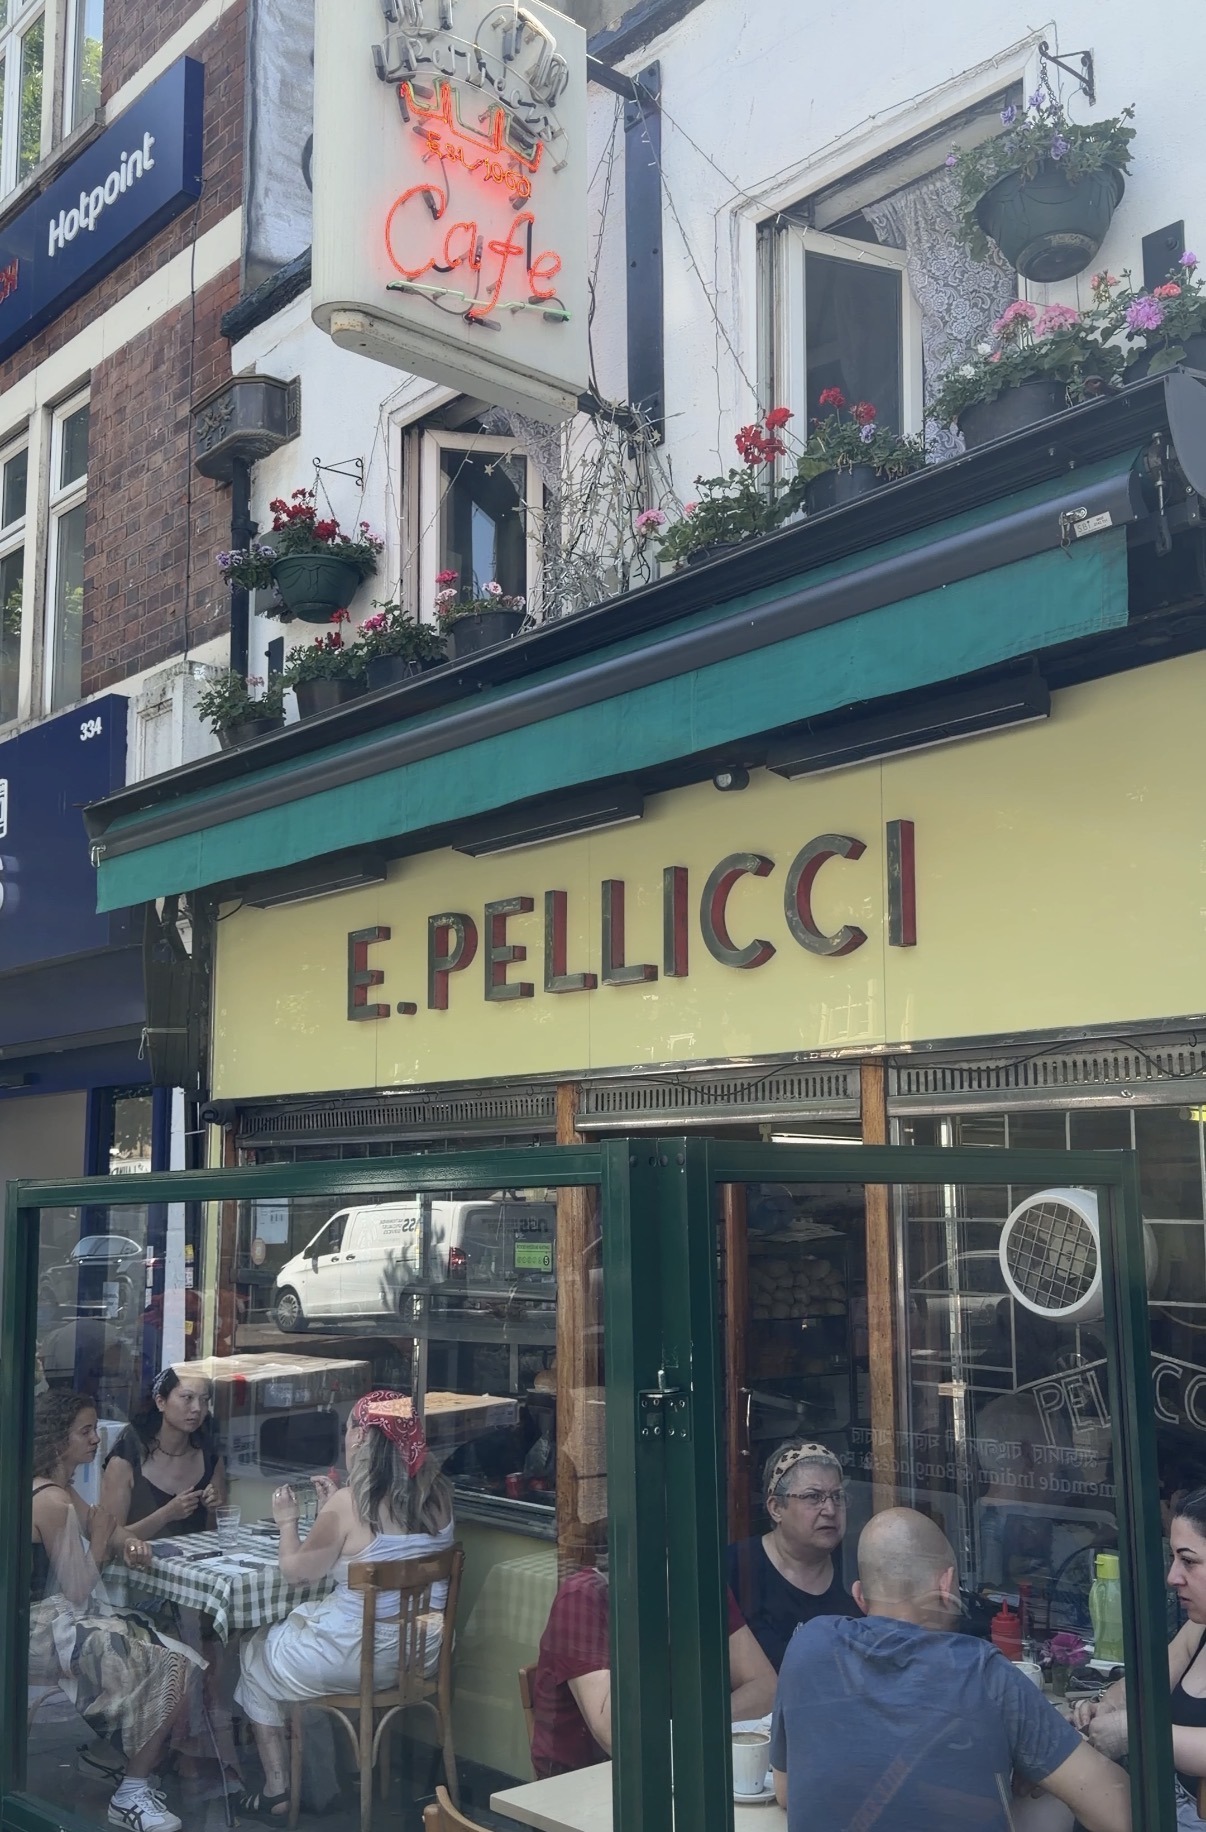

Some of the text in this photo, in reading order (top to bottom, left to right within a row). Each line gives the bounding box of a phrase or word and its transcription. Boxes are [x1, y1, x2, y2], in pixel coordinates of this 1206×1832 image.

[47, 131, 157, 258] Hotpoint
[385, 184, 562, 318] Cafe
[80, 716, 102, 742] 334
[544, 1256, 550, 1267] 5
